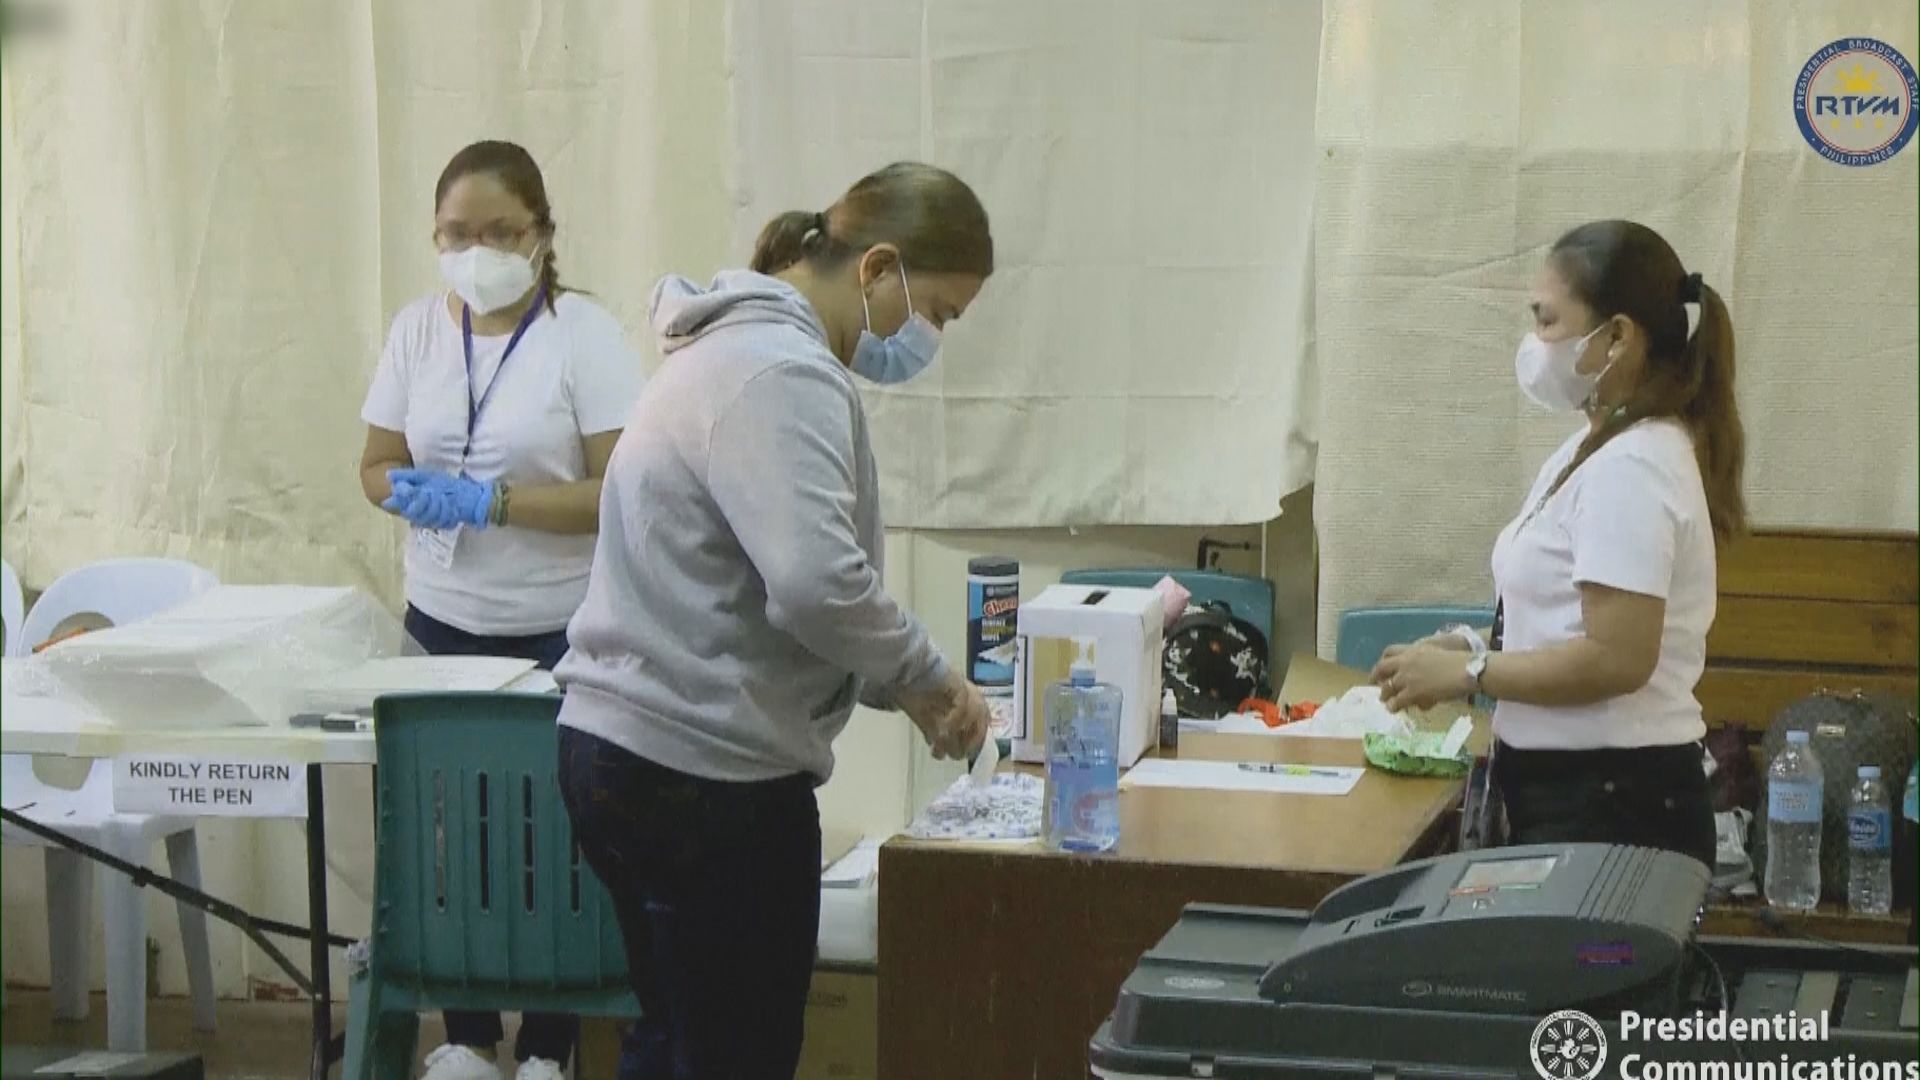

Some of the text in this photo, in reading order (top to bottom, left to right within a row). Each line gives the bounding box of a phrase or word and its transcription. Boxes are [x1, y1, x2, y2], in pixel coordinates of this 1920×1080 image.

[130, 761, 290, 781] KINDLY RETURN
[168, 787, 253, 805] THE PEN
